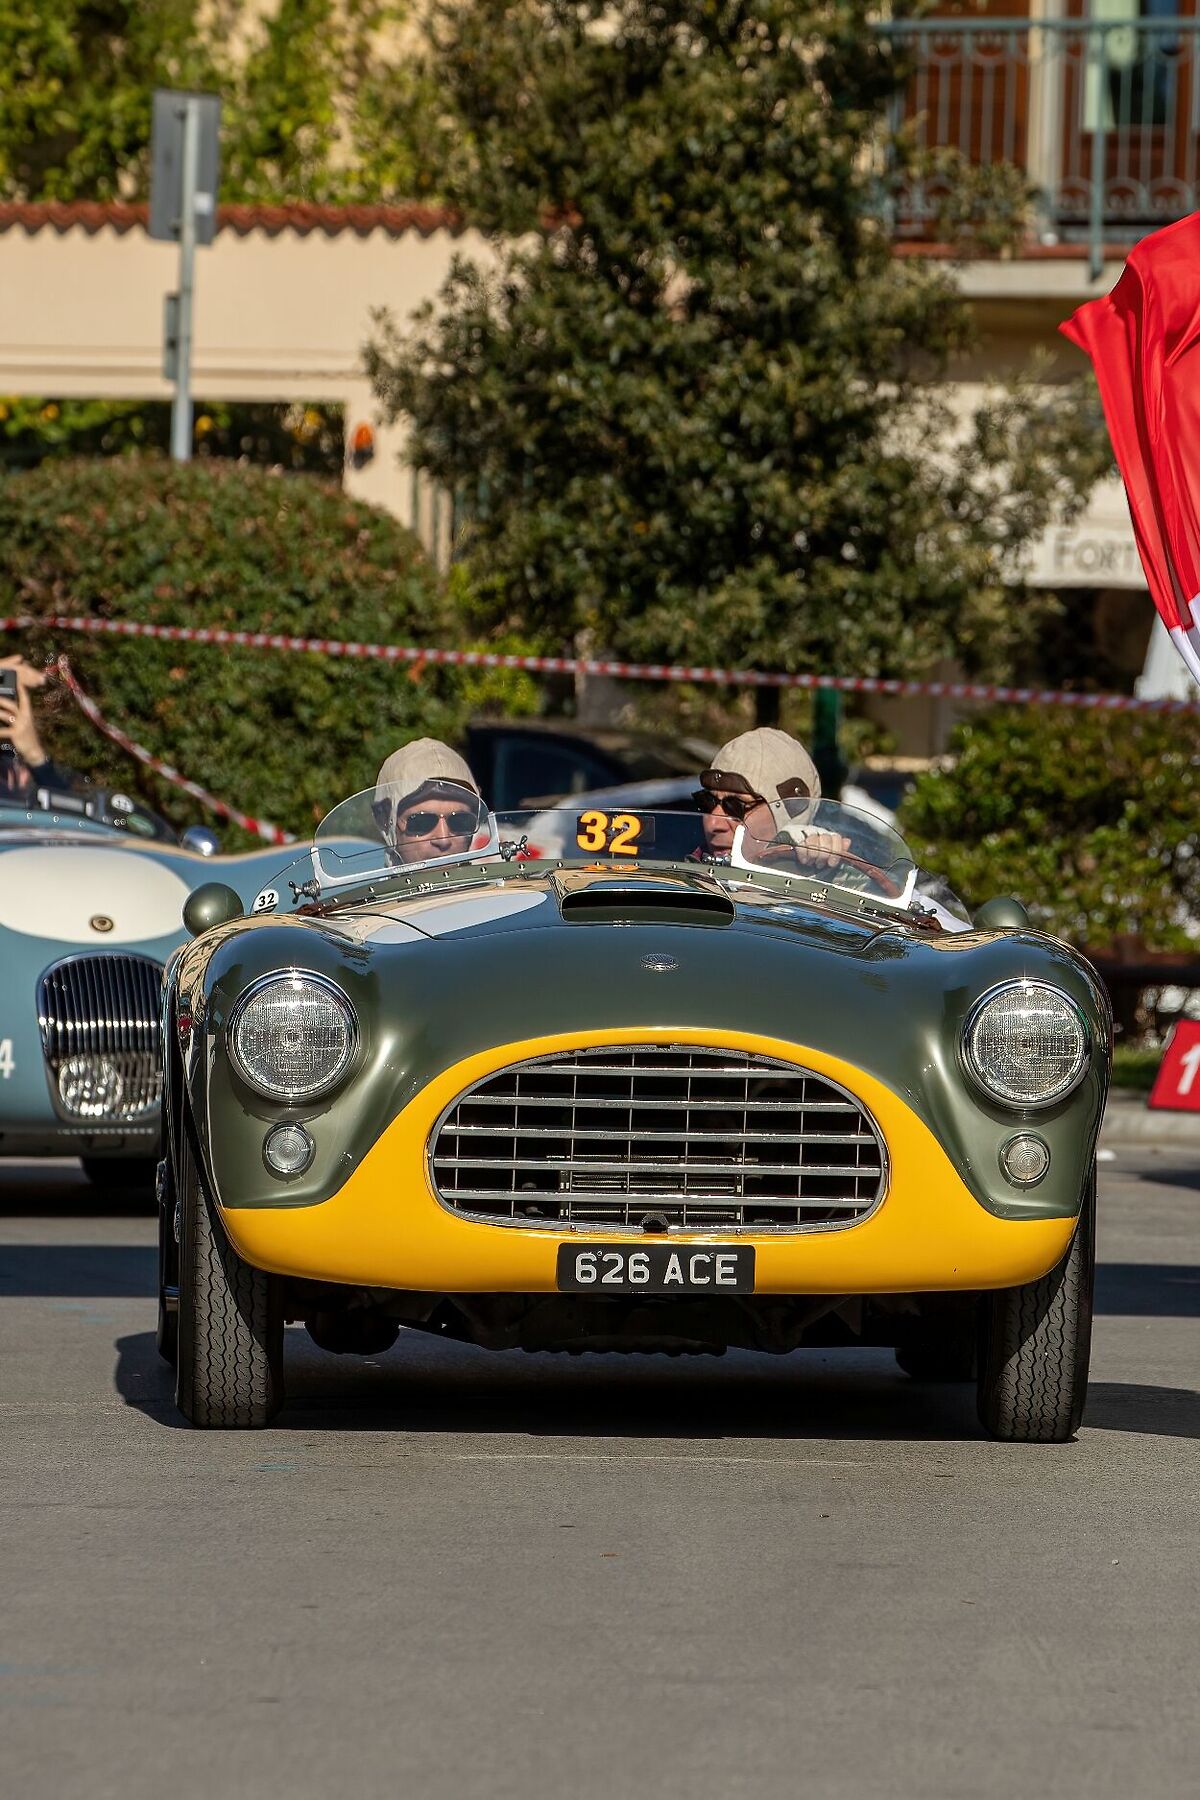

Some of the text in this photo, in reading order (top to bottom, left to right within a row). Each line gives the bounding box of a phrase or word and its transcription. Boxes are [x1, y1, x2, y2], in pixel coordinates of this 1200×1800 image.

[1053, 528, 1141, 574] FORT
[574, 809, 642, 856] 32
[257, 891, 276, 908] 32
[0, 1037, 16, 1080] 4
[575, 1251, 739, 1286] 626 ACE
